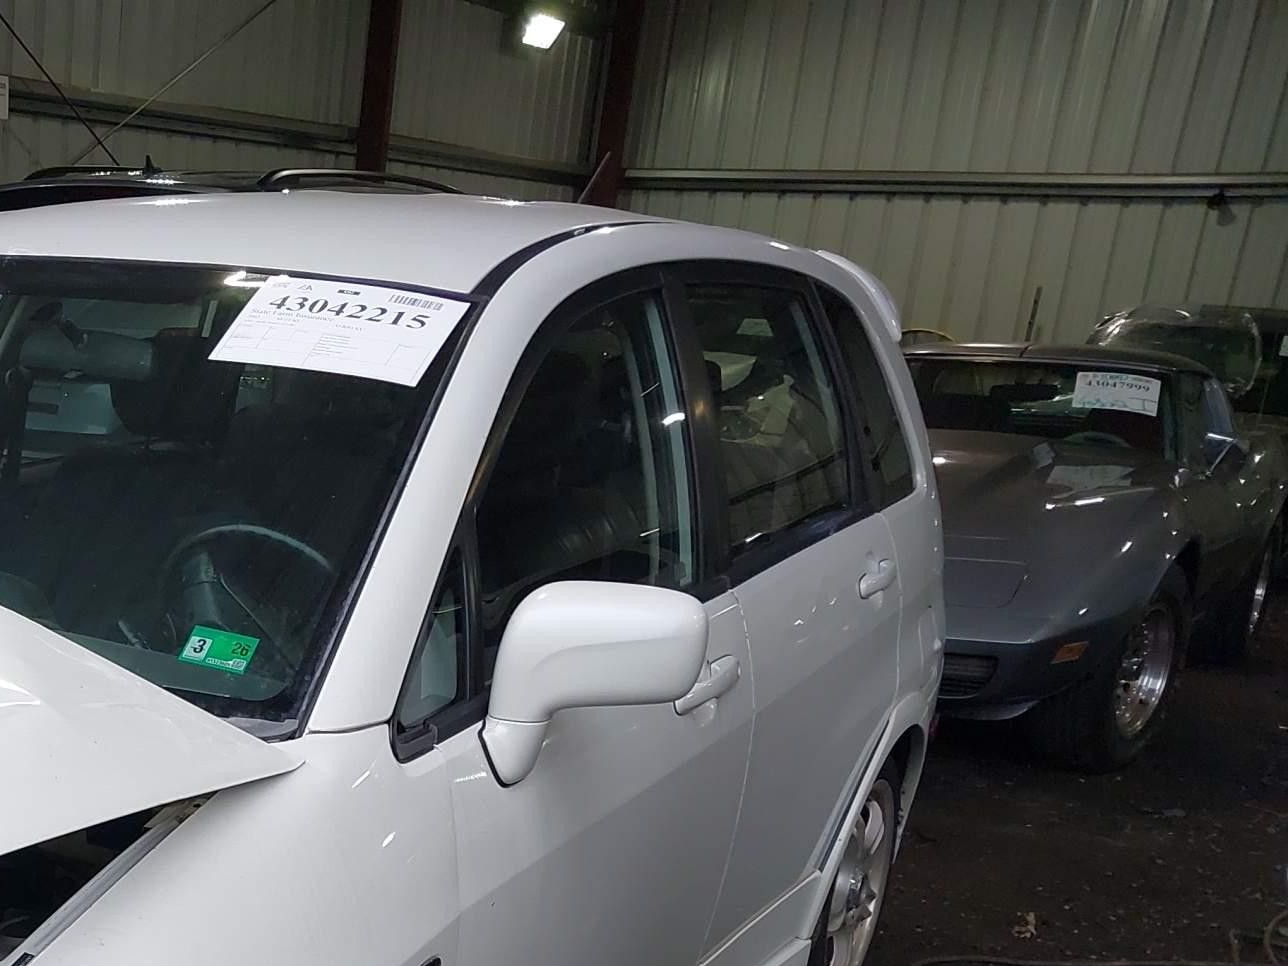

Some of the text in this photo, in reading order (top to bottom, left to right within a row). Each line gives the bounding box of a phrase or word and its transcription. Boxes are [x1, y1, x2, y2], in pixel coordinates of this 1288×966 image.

[268, 294, 432, 330] 43042215
[191, 639, 251, 657] 3 26
